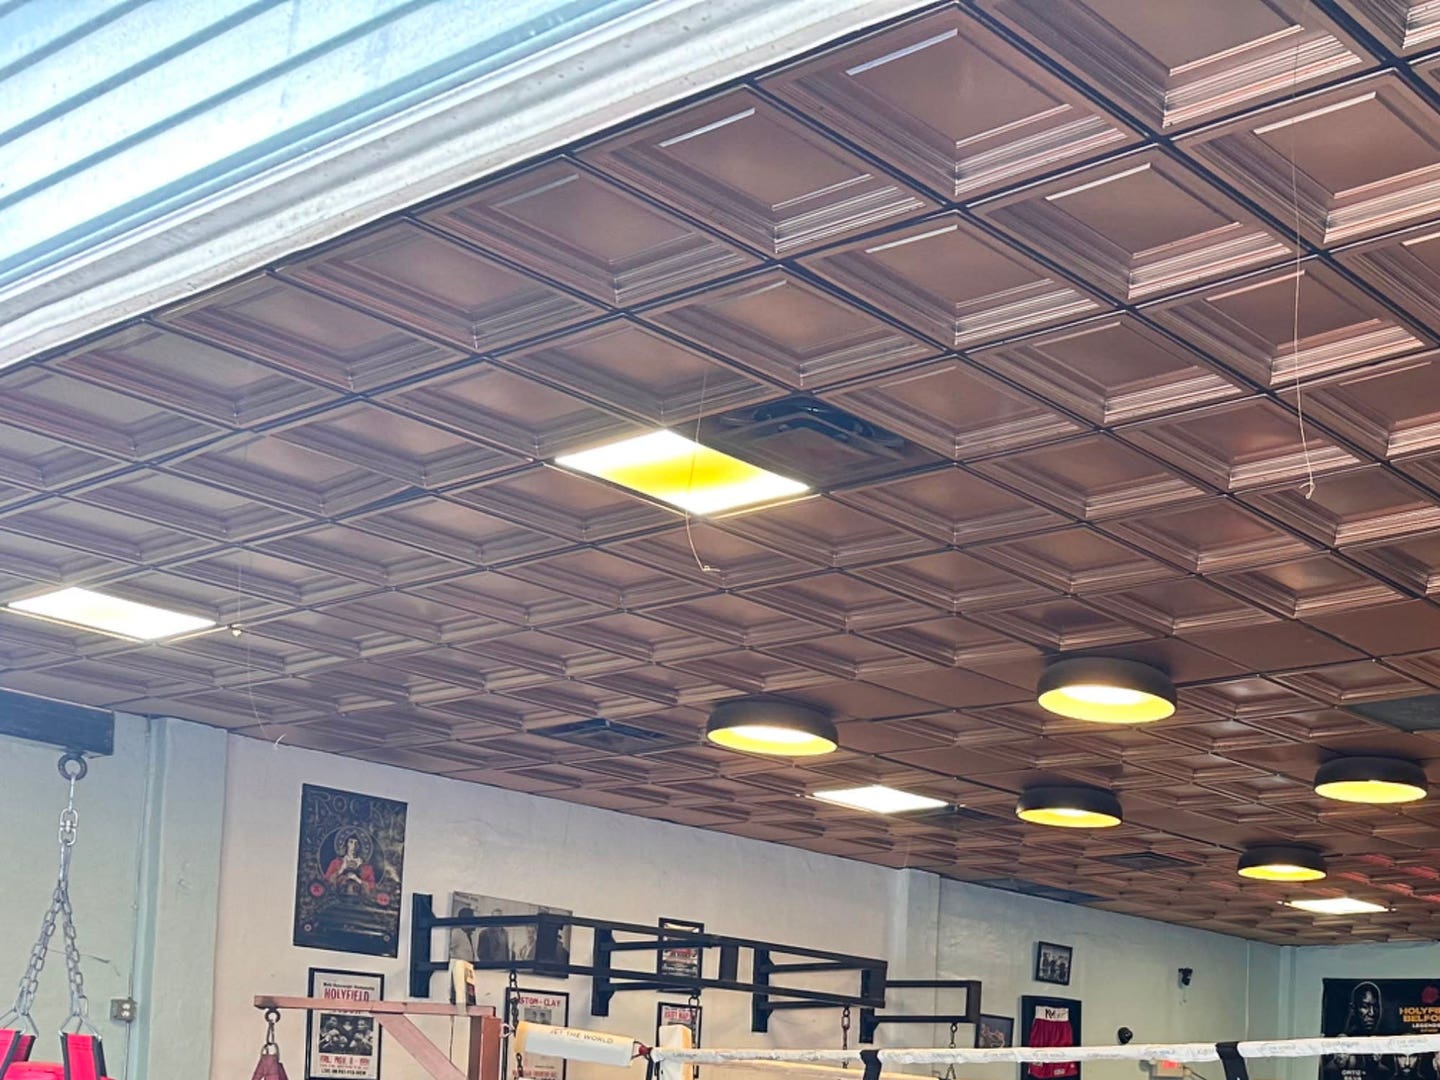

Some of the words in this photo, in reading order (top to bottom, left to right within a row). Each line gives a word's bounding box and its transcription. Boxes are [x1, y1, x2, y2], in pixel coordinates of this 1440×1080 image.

[307, 789, 401, 832] ROCKY
[324, 987, 370, 1002] HOLYFIELD
[584, 1034, 613, 1044] WORLD
